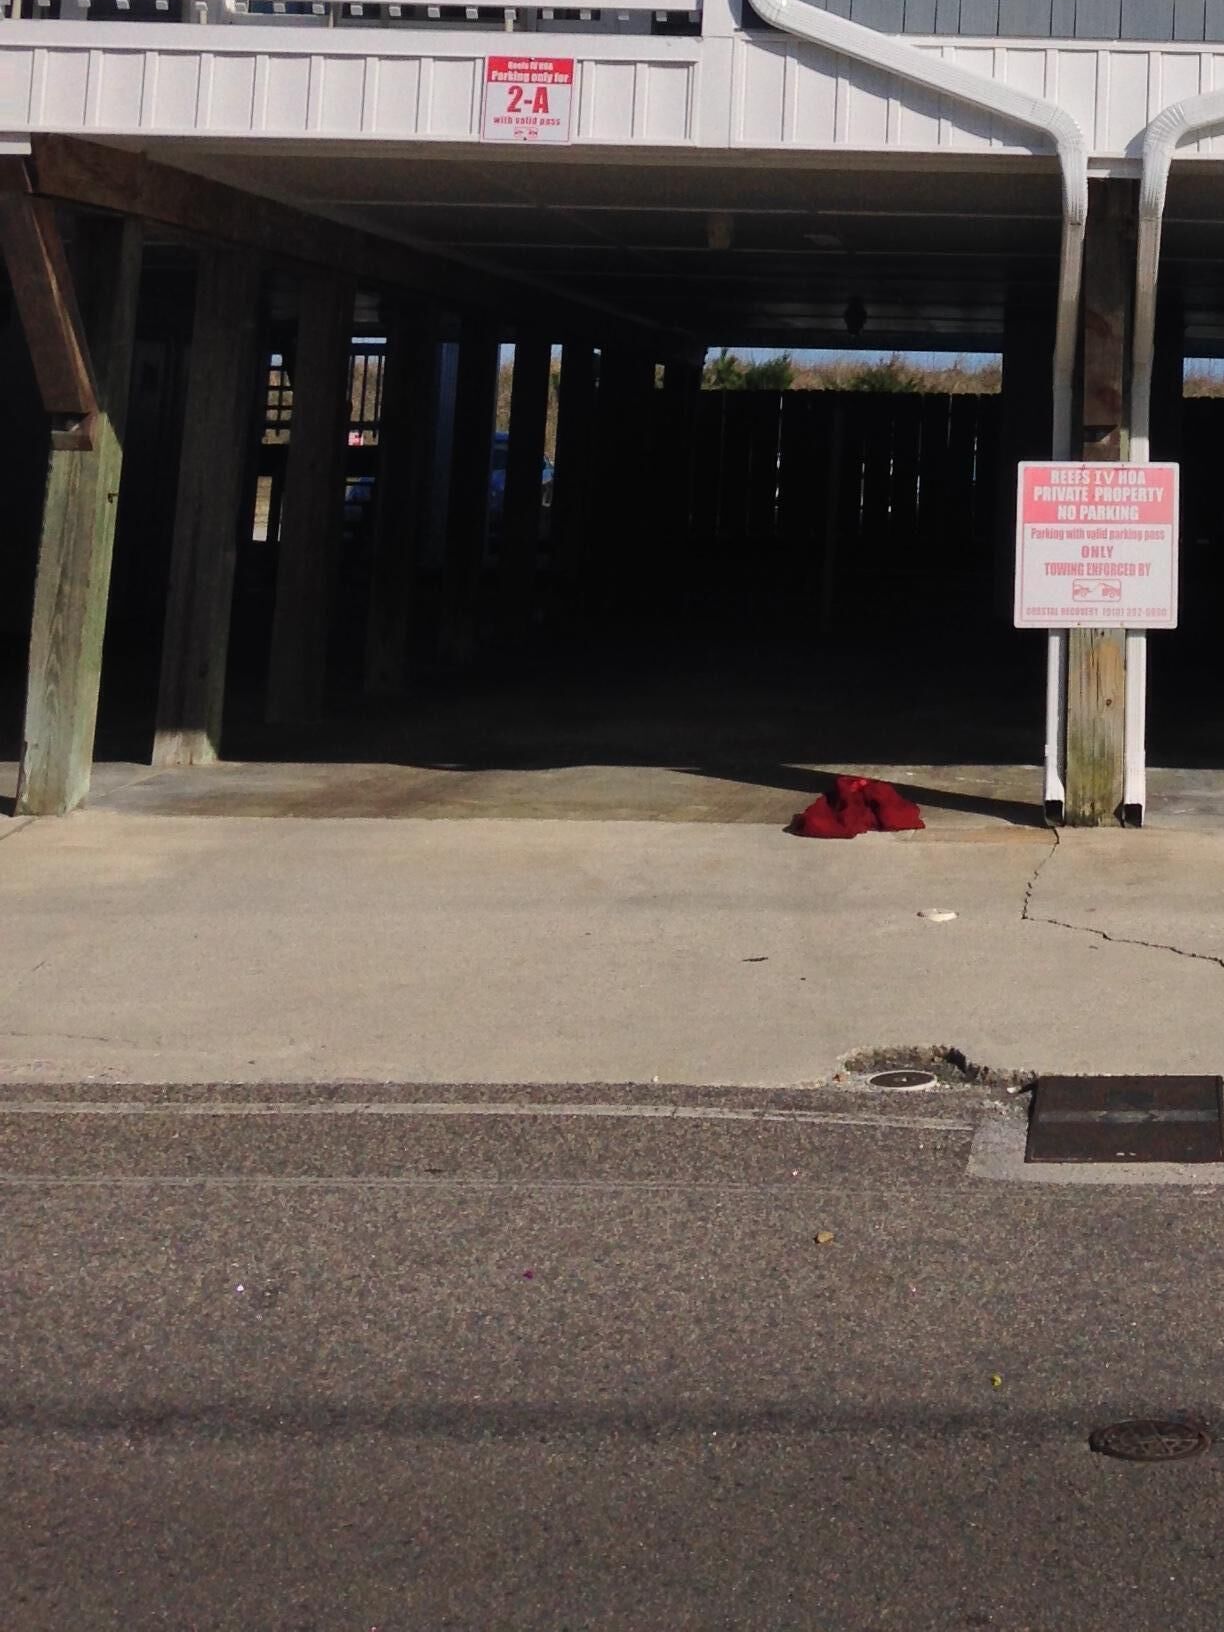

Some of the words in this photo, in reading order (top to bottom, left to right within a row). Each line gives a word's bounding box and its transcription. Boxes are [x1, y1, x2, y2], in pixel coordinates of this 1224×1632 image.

[491, 70, 530, 82] Parking
[531, 72, 553, 83] only
[554, 72, 569, 83] for
[507, 85, 549, 114] 2-A
[493, 117, 513, 125] with
[515, 117, 537, 125] valid
[539, 118, 560, 126] pass
[1050, 470, 1089, 485] REEFS
[1094, 470, 1115, 485] IV
[1118, 470, 1146, 485] HOA
[1033, 486, 1089, 502] PRIVATE
[1094, 487, 1164, 502] PROPERTY
[1057, 505, 1076, 520] NO
[1079, 505, 1139, 521] PARKING
[1031, 528, 1063, 541] Parking
[1064, 528, 1085, 539] with
[1086, 529, 1108, 540] valid
[1109, 529, 1143, 541] parking
[1144, 530, 1165, 541] pass
[1081, 545, 1114, 558] ONLY
[1044, 562, 1084, 576] TOWING
[1086, 562, 1136, 576] ENFORCED
[1138, 563, 1151, 576] BY
